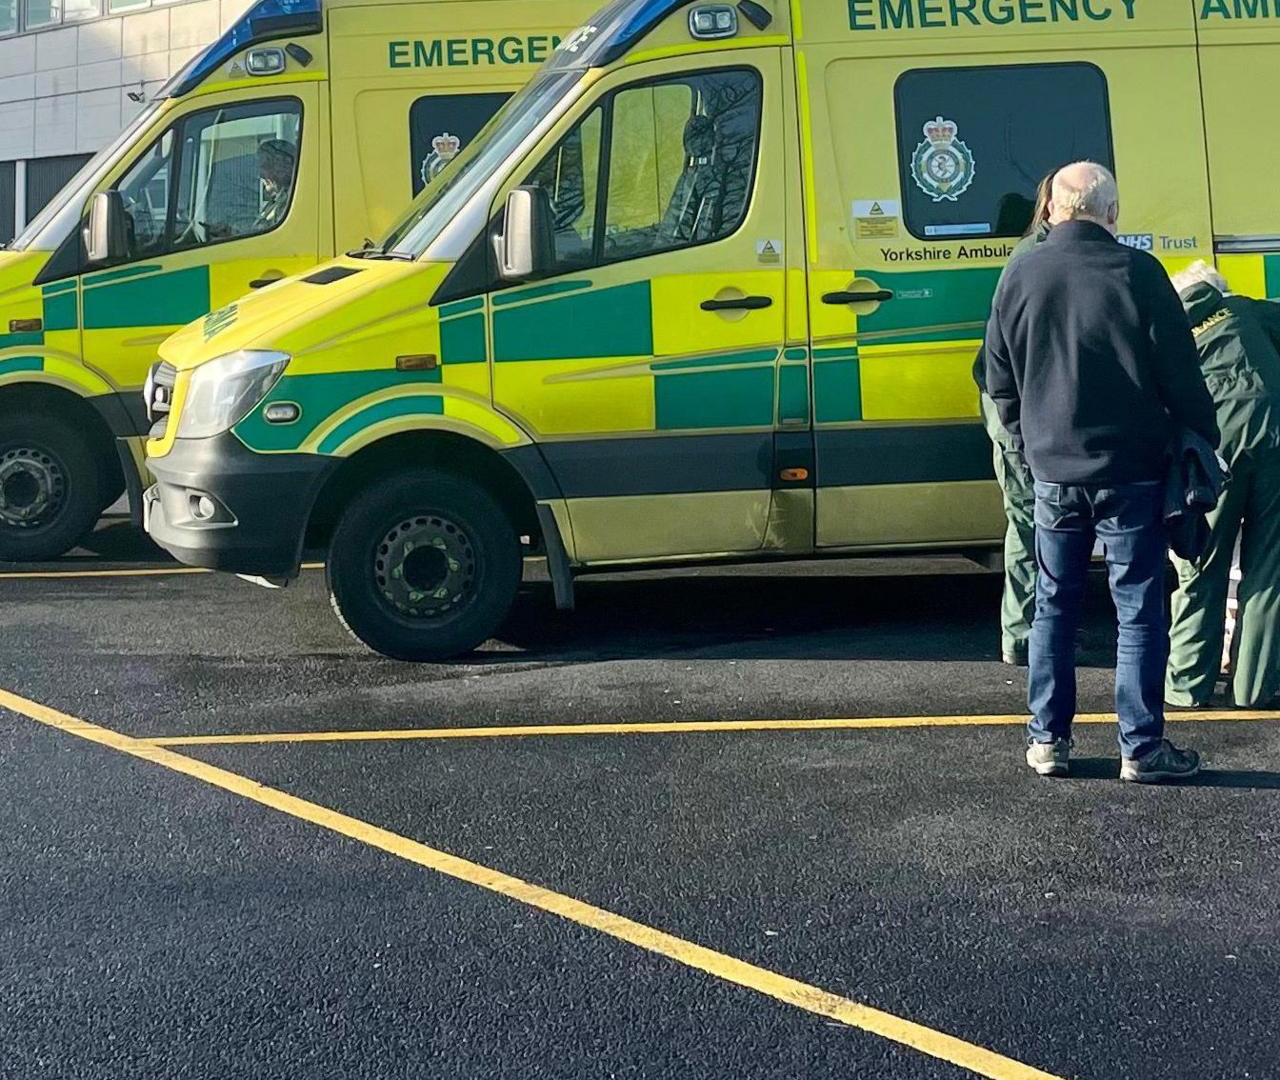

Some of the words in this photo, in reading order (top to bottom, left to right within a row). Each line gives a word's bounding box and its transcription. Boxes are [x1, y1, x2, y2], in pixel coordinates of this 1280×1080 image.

[880, 246, 952, 262] Yorkshire
[957, 244, 1015, 260] Ambula
[1158, 235, 1198, 249] Trust
